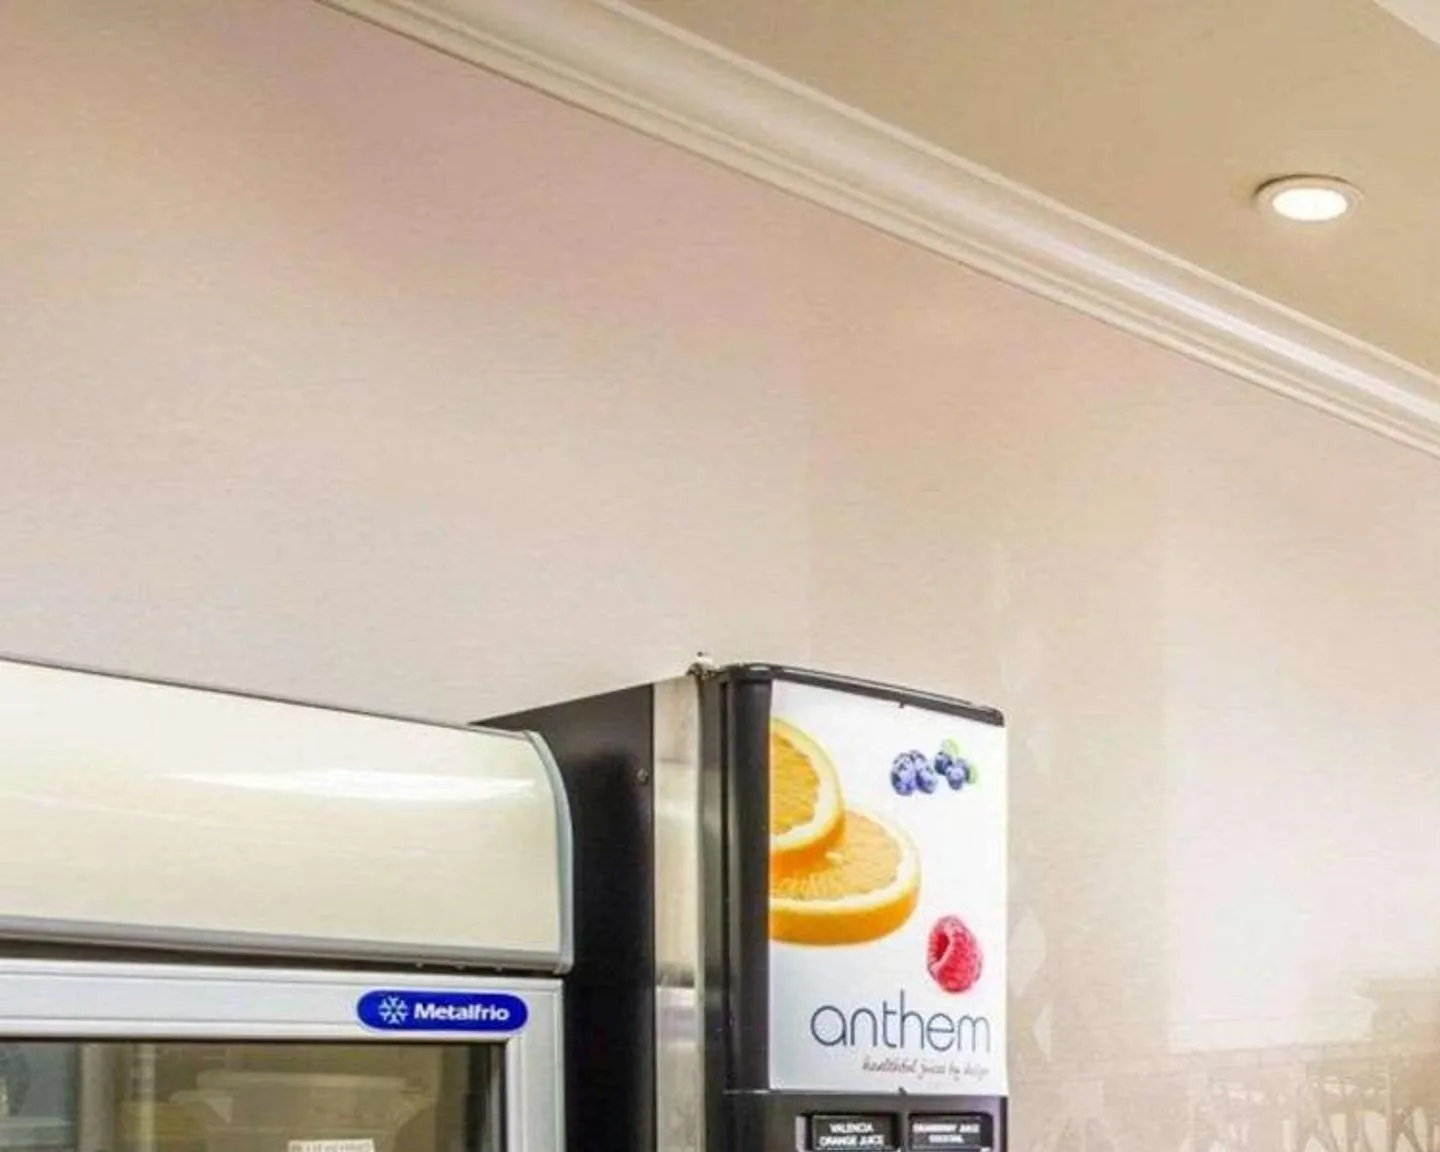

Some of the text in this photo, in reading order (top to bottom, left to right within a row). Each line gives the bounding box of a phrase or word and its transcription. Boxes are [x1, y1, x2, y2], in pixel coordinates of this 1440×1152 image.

[414, 1002, 510, 1021] Metalfrio
[810, 988, 991, 1053] anthem
[829, 1122, 874, 1134] VALENCIA
[819, 1134, 886, 1147] ORANGE JUICE
